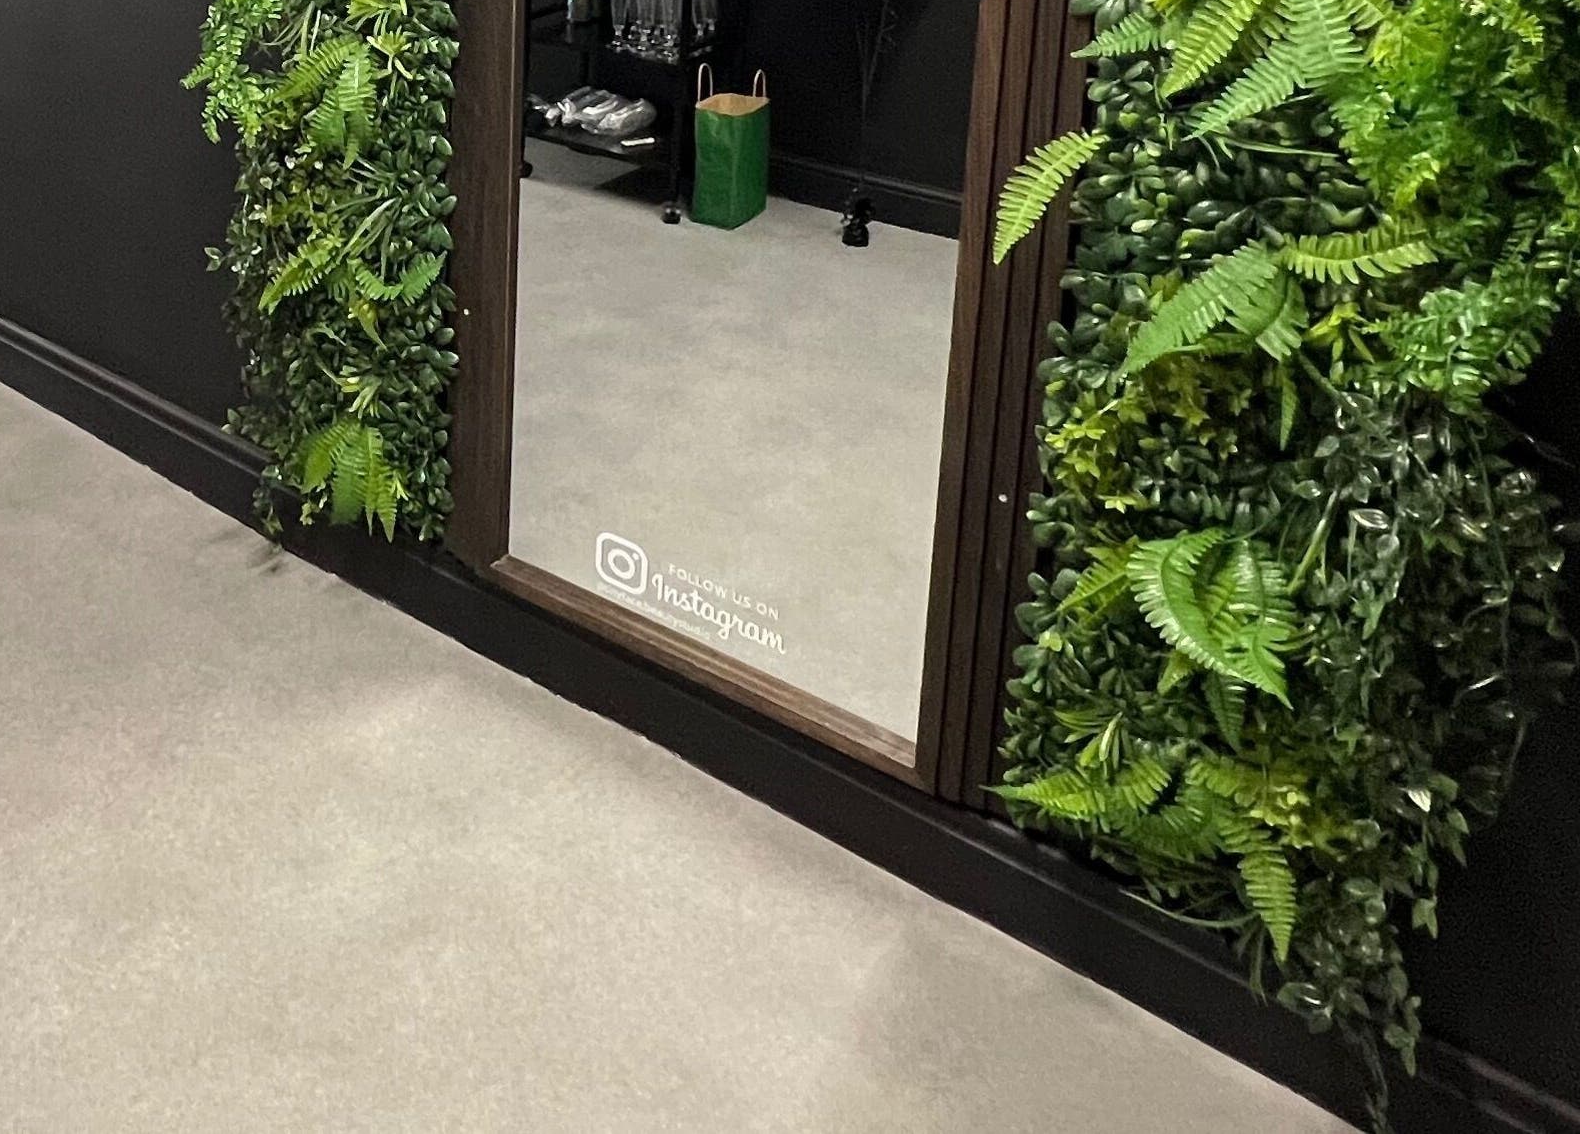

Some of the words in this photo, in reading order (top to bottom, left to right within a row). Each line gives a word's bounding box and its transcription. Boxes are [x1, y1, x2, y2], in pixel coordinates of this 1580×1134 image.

[651, 573, 786, 655] Instagram
[668, 563, 728, 600] FOLLOW
[732, 589, 752, 609] US
[756, 602, 780, 621] ON
